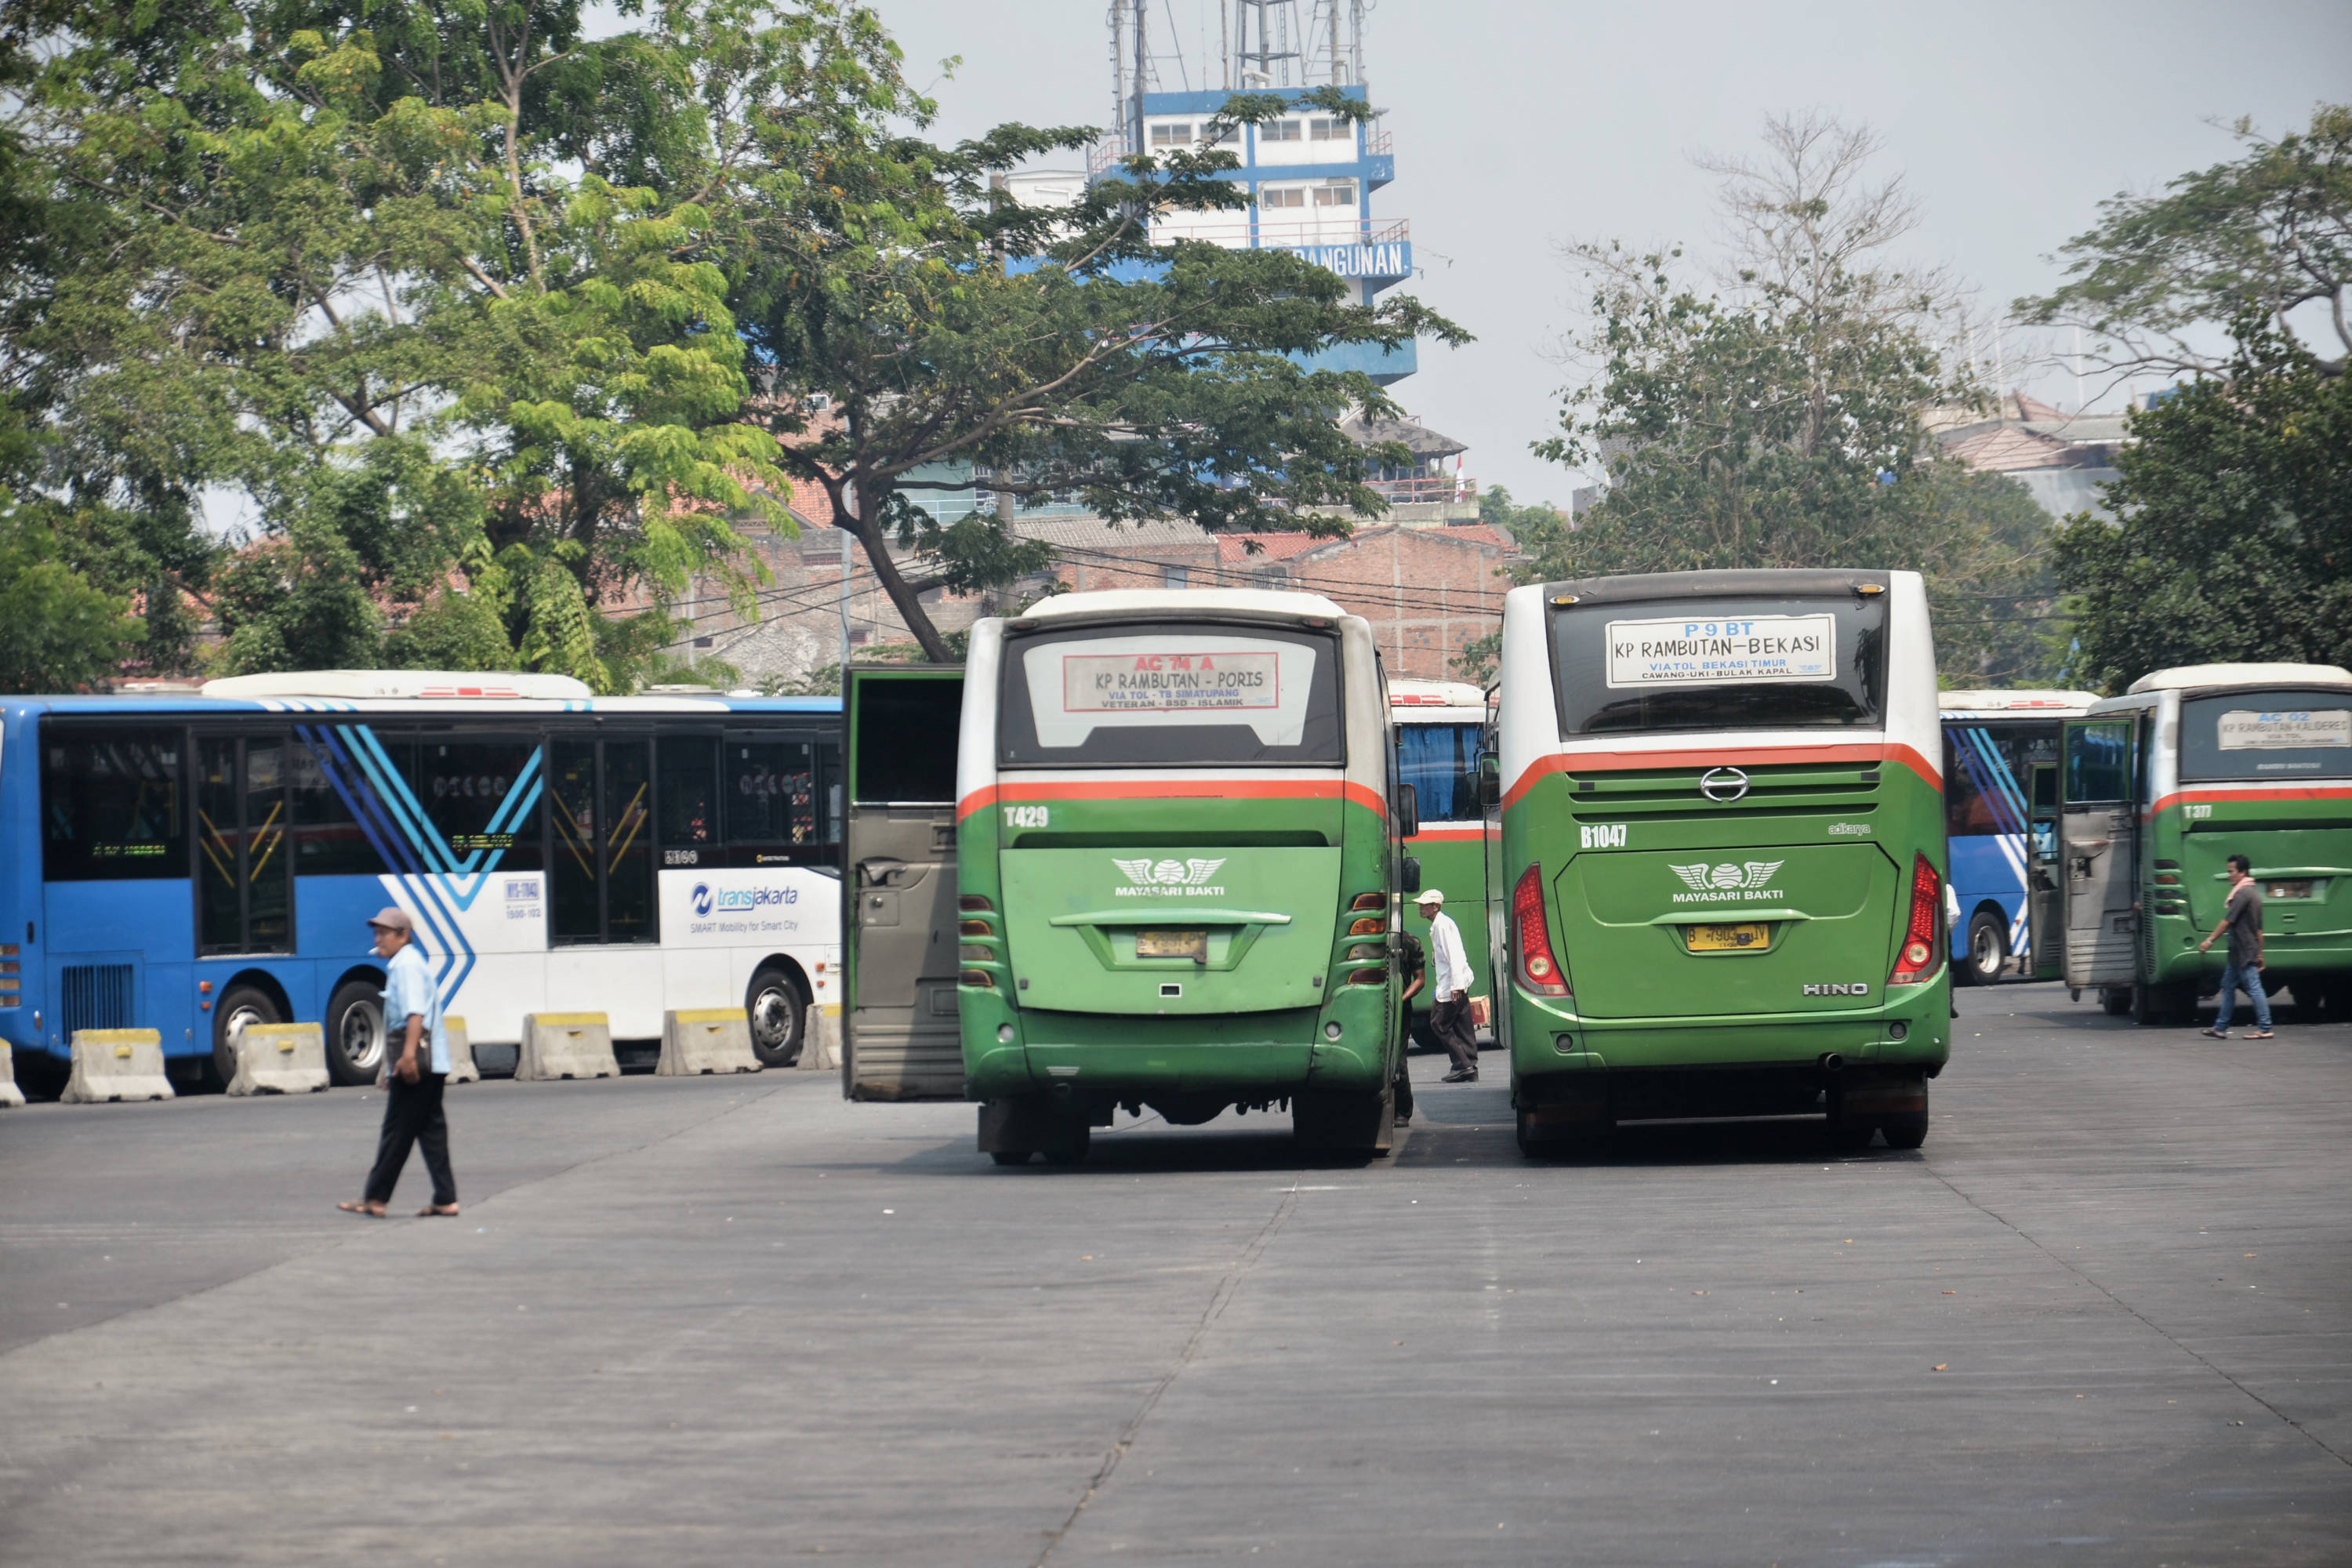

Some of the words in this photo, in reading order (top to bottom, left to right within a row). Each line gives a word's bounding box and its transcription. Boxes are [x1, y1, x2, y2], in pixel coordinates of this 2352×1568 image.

[1685, 624, 1698, 637] P
[1704, 623, 1718, 637] 9
[1726, 622, 1754, 636] BT
[1616, 642, 1634, 659] KP
[1134, 657, 1162, 671] AC
[1168, 655, 1191, 670] 74
[1200, 656, 1214, 670] A
[1702, 660, 1748, 670] BEKASI
[1751, 659, 1786, 667] TIMUR
[1095, 673, 1112, 689] KP
[1119, 672, 1199, 689] RAMBUTAN
[1218, 671, 1263, 688] PORIS
[1109, 691, 1127, 699] VIA
[1130, 691, 1149, 699] TOL
[1175, 688, 1240, 698] SIMATUPANG
[2258, 713, 2283, 722] AC
[2288, 713, 2310, 721] 02
[1004, 806, 1049, 828] T429
[1581, 824, 1627, 848] B1047
[1115, 886, 1182, 896] MAYASARI
[1185, 886, 1225, 896] BAKTI
[1673, 891, 1740, 902] MAYASARI
[1744, 889, 1784, 900] BAKTI
[717, 886, 798, 912] transjakarta
[691, 923, 717, 934] SMART
[719, 921, 747, 934] Mobility
[749, 921, 759, 931] for
[761, 920, 782, 931] Smart
[784, 920, 798, 931] City
[1689, 928, 1696, 942] B
[1803, 983, 1868, 996] HINO
